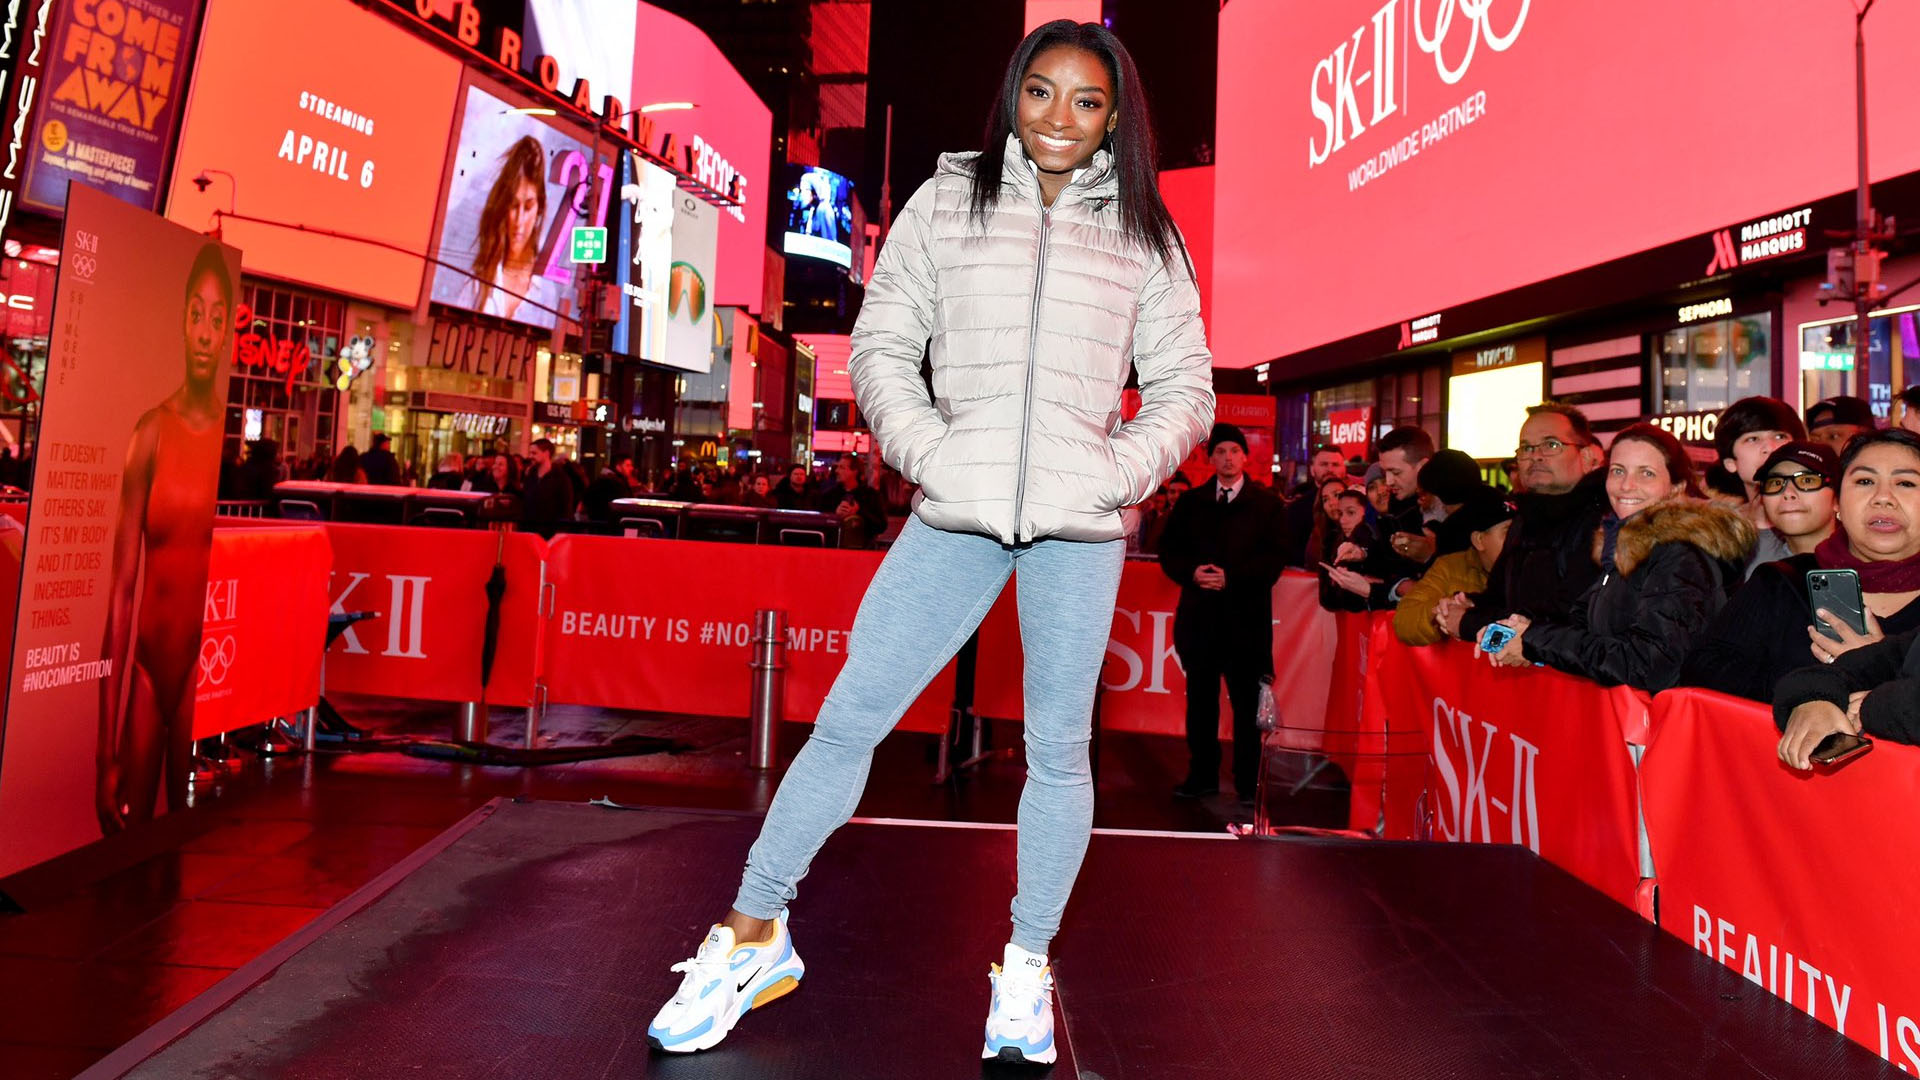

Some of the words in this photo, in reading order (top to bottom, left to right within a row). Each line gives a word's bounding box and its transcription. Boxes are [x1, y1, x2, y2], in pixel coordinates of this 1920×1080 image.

[73, 0, 181, 61] COME
[53, 66, 169, 131] AWAY
[299, 90, 374, 136] STREAMING
[1348, 130, 1420, 192] WORLDWIDE
[1420, 90, 1487, 150] PARTNER
[278, 129, 350, 182] APRIL
[360, 160, 375, 189] 6
[1741, 208, 1812, 242] MARRIOTT
[75, 230, 98, 253] SK-II
[1741, 232, 1804, 261] MARQUIS
[1678, 298, 1733, 323] SEPHORA
[427, 317, 534, 382] FOREVER
[451, 412, 497, 434] FOREVER
[1650, 413, 1718, 442] EPHO
[50, 443, 61, 463] IT
[63, 444, 107, 465] DOESN'T
[47, 470, 88, 490] MATTER
[90, 473, 118, 491] WHAT
[44, 499, 84, 517] OTHERS
[40, 526, 61, 545] IT'S
[63, 526, 80, 543] MY
[81, 526, 109, 544] BODY
[36, 554, 59, 573] AND
[62, 553, 73, 571] IT
[74, 552, 101, 571] DOES
[33, 579, 95, 601] INCREDIBLE
[31, 607, 71, 630] THINGS.
[561, 611, 656, 640] BEAUTY
[666, 618, 690, 642] IS
[26, 643, 69, 669] BEAUTY
[70, 641, 80, 662] IS
[23, 658, 113, 693] #NOCOMPETITION
[1433, 696, 1540, 856] SK-II
[1694, 904, 1851, 1036] BEAUTY
